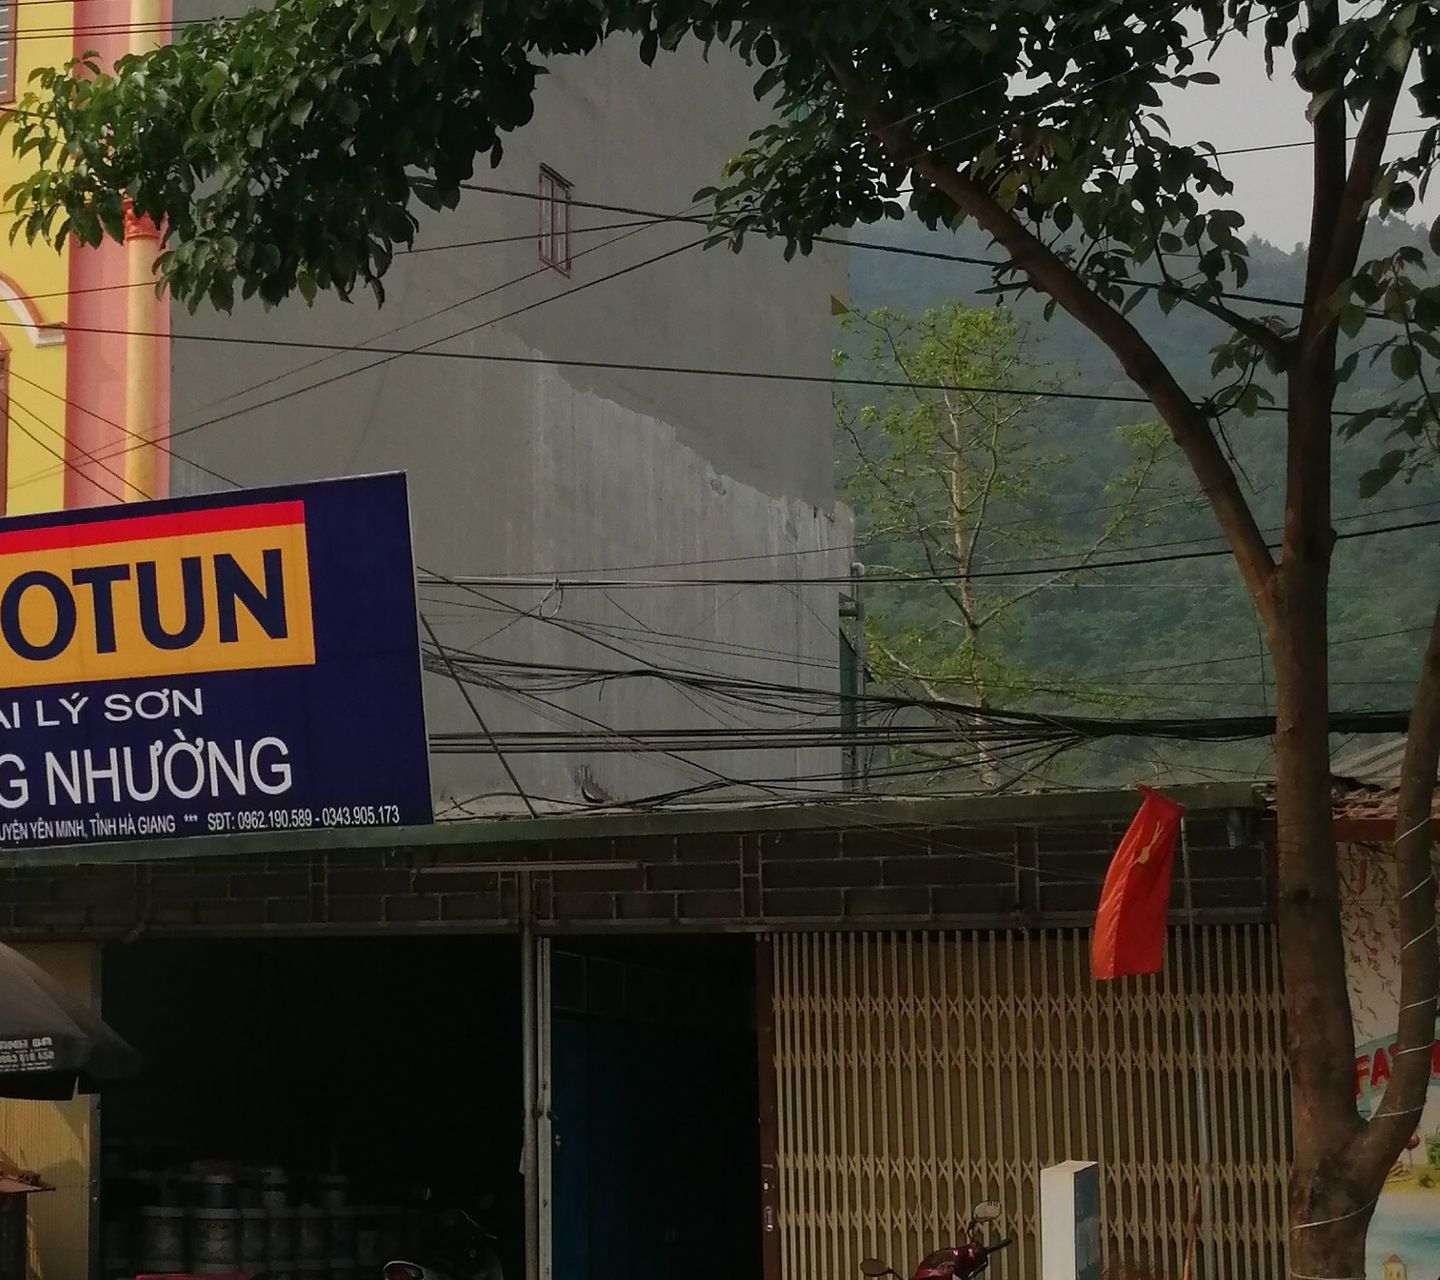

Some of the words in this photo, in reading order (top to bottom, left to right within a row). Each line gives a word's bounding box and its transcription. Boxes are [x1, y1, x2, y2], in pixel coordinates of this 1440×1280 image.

[35, 692, 87, 728] LÝ
[104, 687, 204, 723] SƠN
[45, 728, 293, 806] NHƯỜNG
[29, 817, 54, 840] YÊN
[55, 820, 88, 840] MINH,
[89, 811, 117, 837] TỈNH
[118, 809, 136, 835] HÀ
[137, 814, 176, 834] GIANG
[207, 811, 235, 831] SĐT:
[237, 807, 312, 830] 0962.190.589
[322, 804, 401, 827] 0343.905.173
